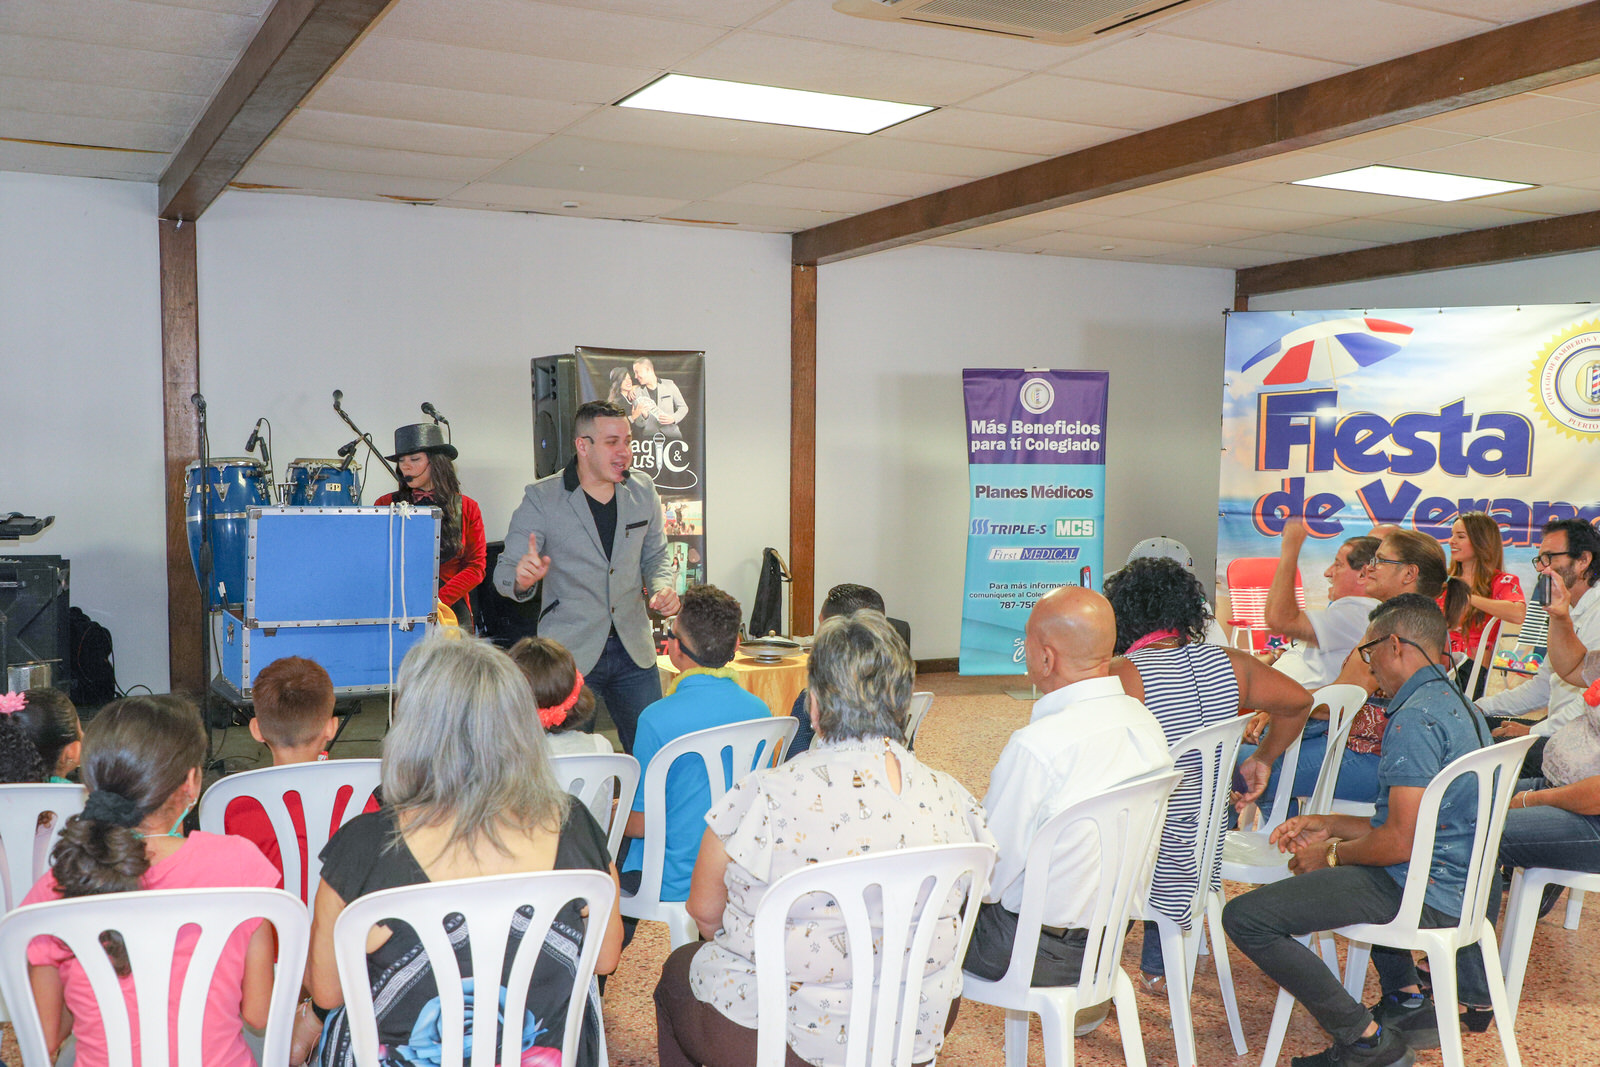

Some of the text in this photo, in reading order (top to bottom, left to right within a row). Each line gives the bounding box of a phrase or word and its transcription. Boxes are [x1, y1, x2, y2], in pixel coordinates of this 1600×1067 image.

[971, 419, 1101, 436] Más Beneficios
[971, 437, 1100, 454] para tí Colegiado
[975, 485, 1094, 499] Planes Médicos
[1251, 477, 1346, 539] de
[990, 524, 1047, 535] TRIPLE-S
[1056, 520, 1094, 536] MCS
[993, 548, 1077, 560] First MEDICAL
[989, 582, 1009, 590] Para
[1010, 581, 1027, 590] más
